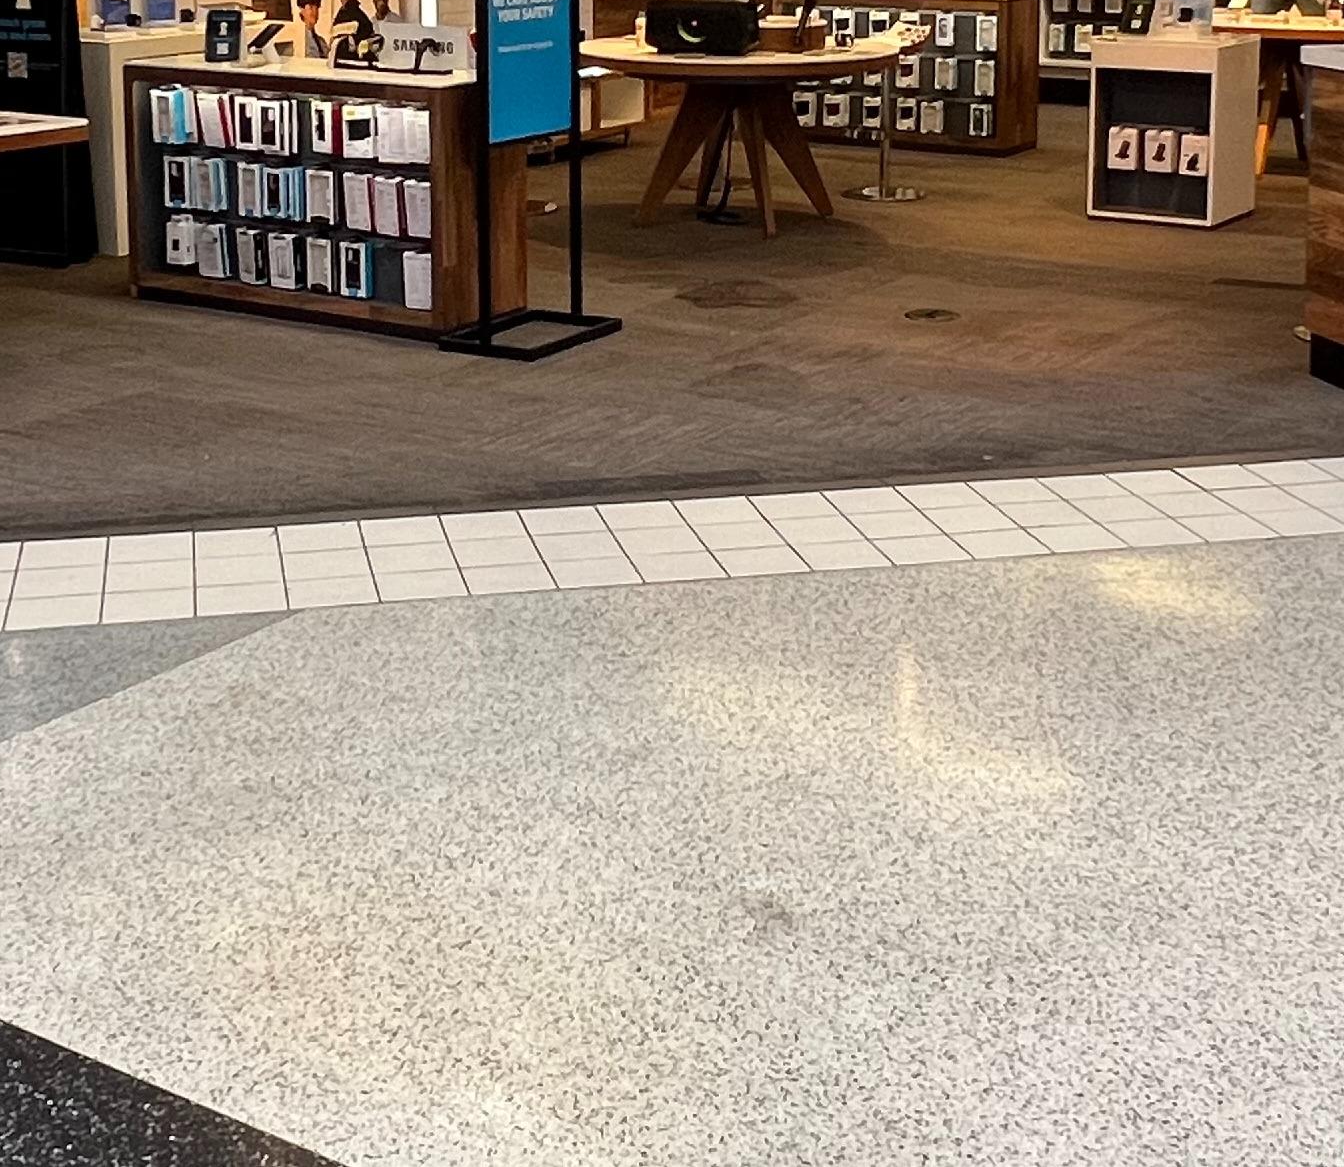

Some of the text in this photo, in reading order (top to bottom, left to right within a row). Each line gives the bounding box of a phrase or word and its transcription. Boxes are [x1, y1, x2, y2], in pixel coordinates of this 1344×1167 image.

[498, 5, 554, 23] YOUR SAFETY
[393, 39, 454, 54] SAMNG
